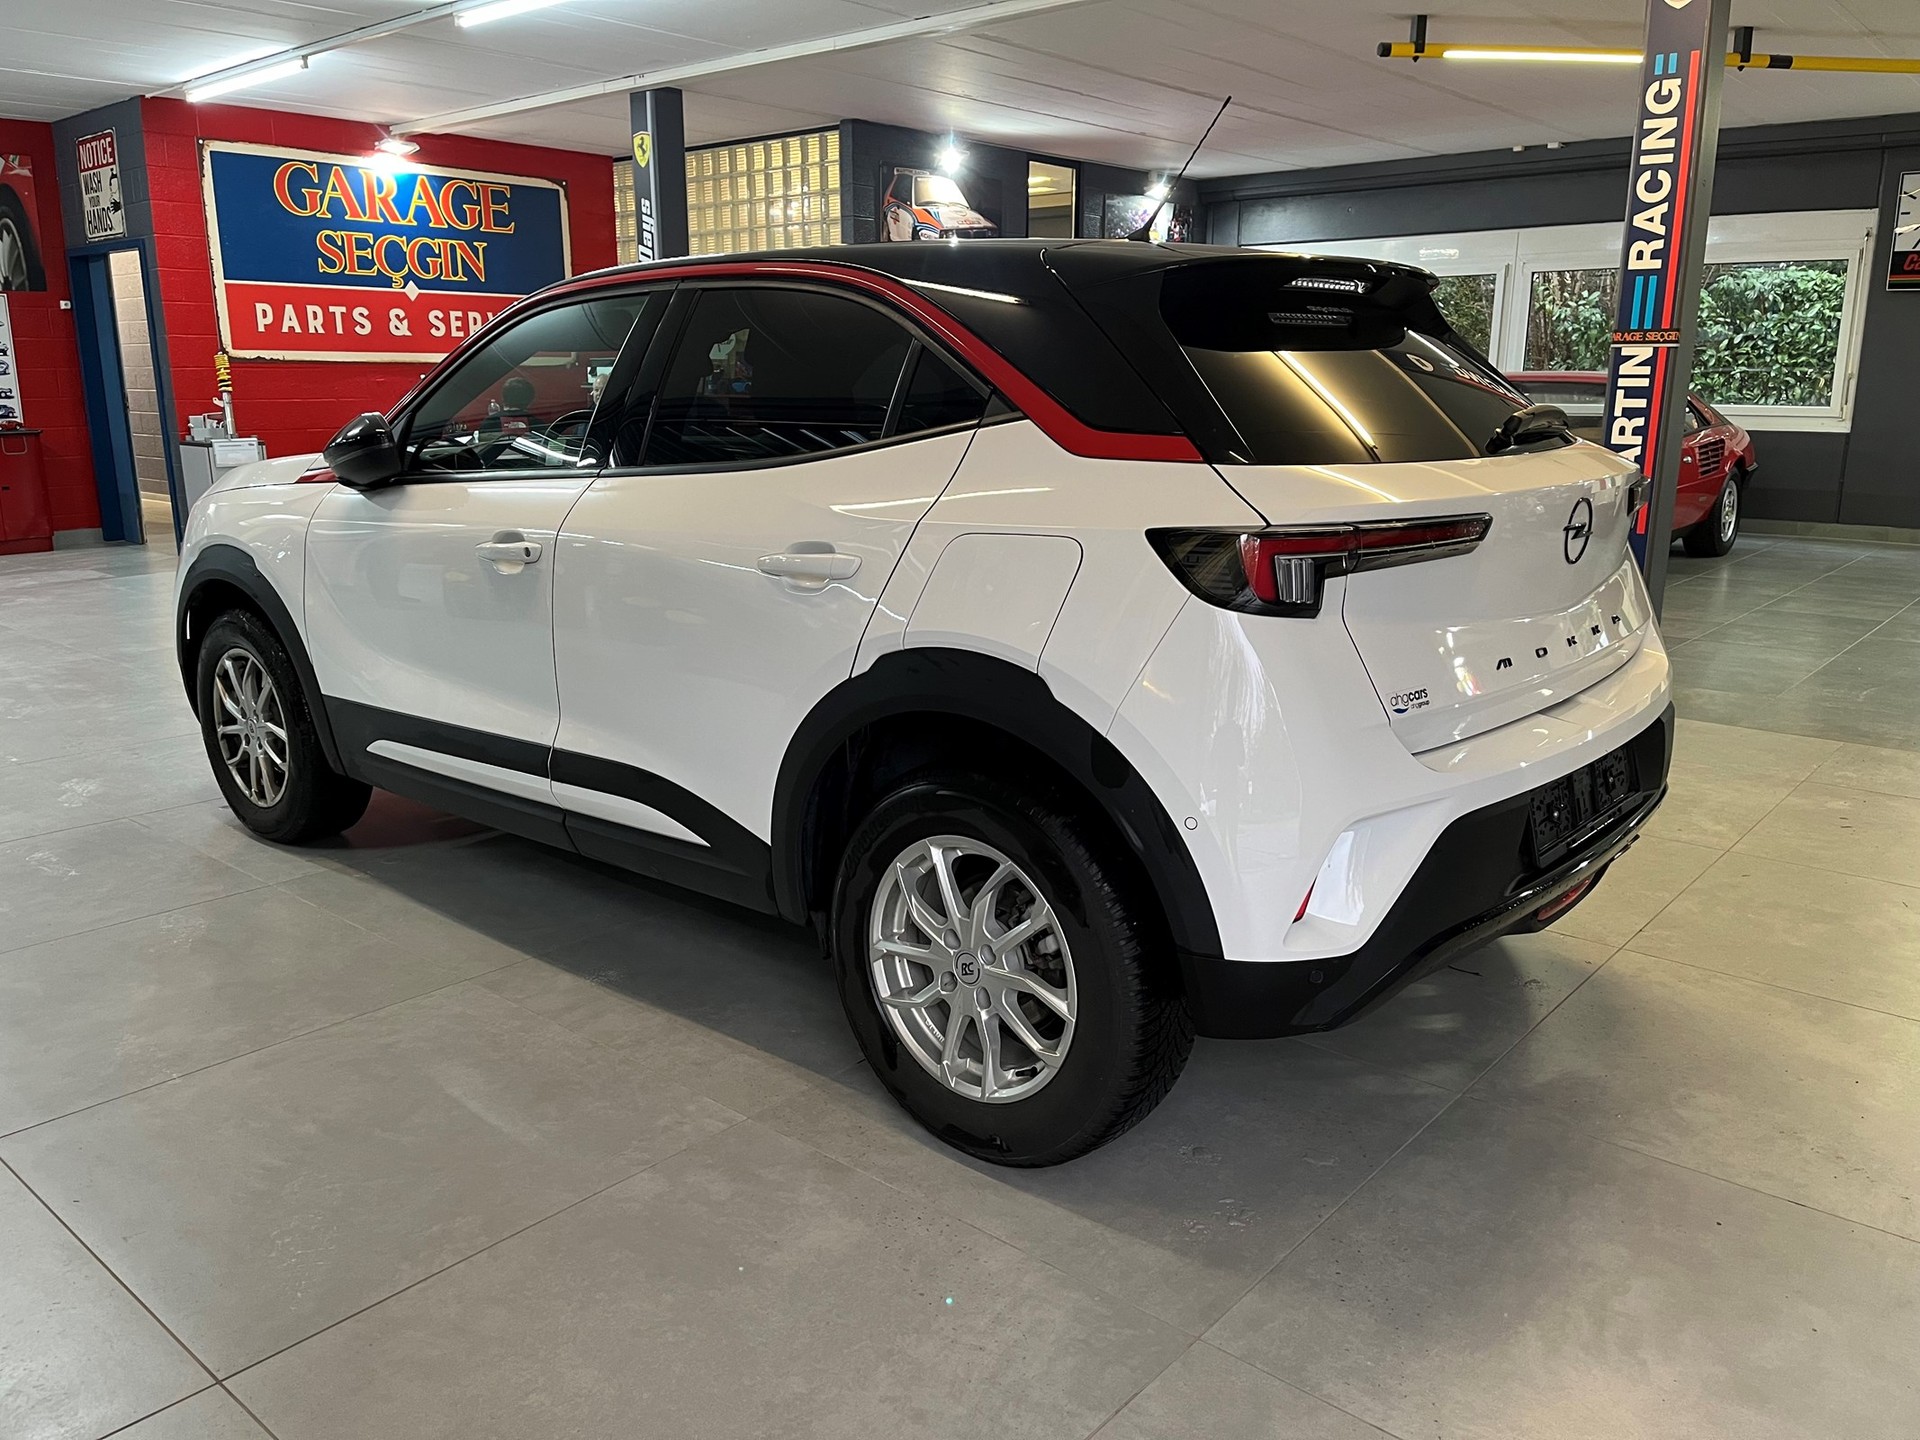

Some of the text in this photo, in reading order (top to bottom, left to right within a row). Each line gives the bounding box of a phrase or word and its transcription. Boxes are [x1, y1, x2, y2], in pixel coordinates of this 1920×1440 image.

[79, 137, 114, 170] NOTICE
[82, 171, 103, 196] WASH
[1628, 78, 1682, 270] RACING
[88, 195, 101, 208] YOUR
[273, 161, 516, 234] GARAGE
[86, 206, 114, 235] HANDS
[316, 230, 488, 289] SEÇGIN
[254, 302, 372, 336] PARTS
[388, 308, 413, 337] &
[1496, 615, 1621, 670] MOKKA
